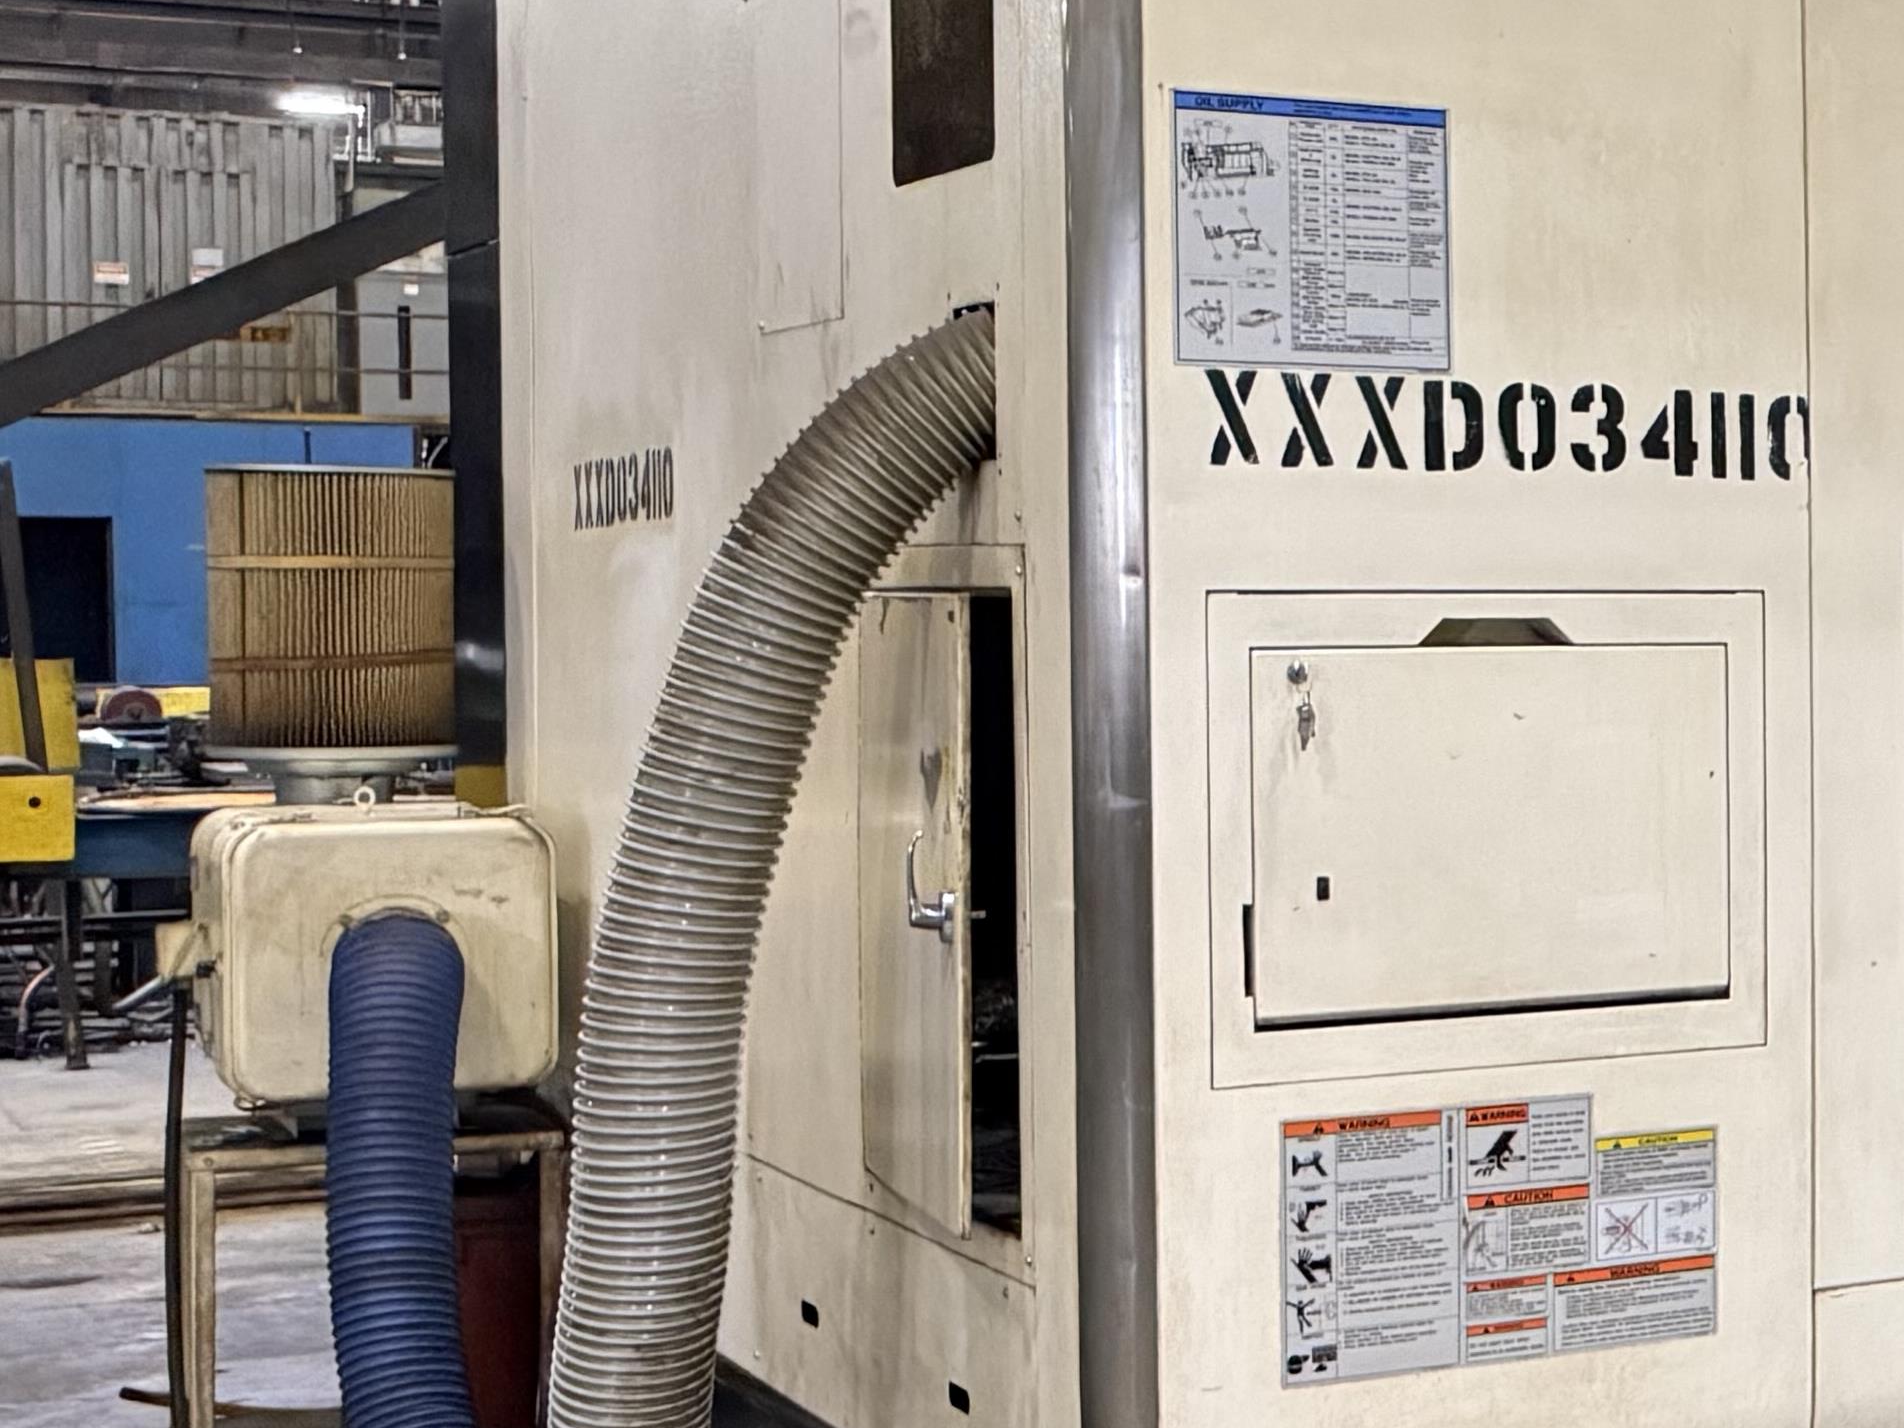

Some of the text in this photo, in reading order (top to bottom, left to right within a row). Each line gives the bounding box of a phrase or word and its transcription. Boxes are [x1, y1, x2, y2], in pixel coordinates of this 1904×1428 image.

[1481, 1109, 1526, 1121] WARNING
[1338, 1117, 1391, 1131] WARNING
[1503, 1191, 1553, 1204] CAUTION
